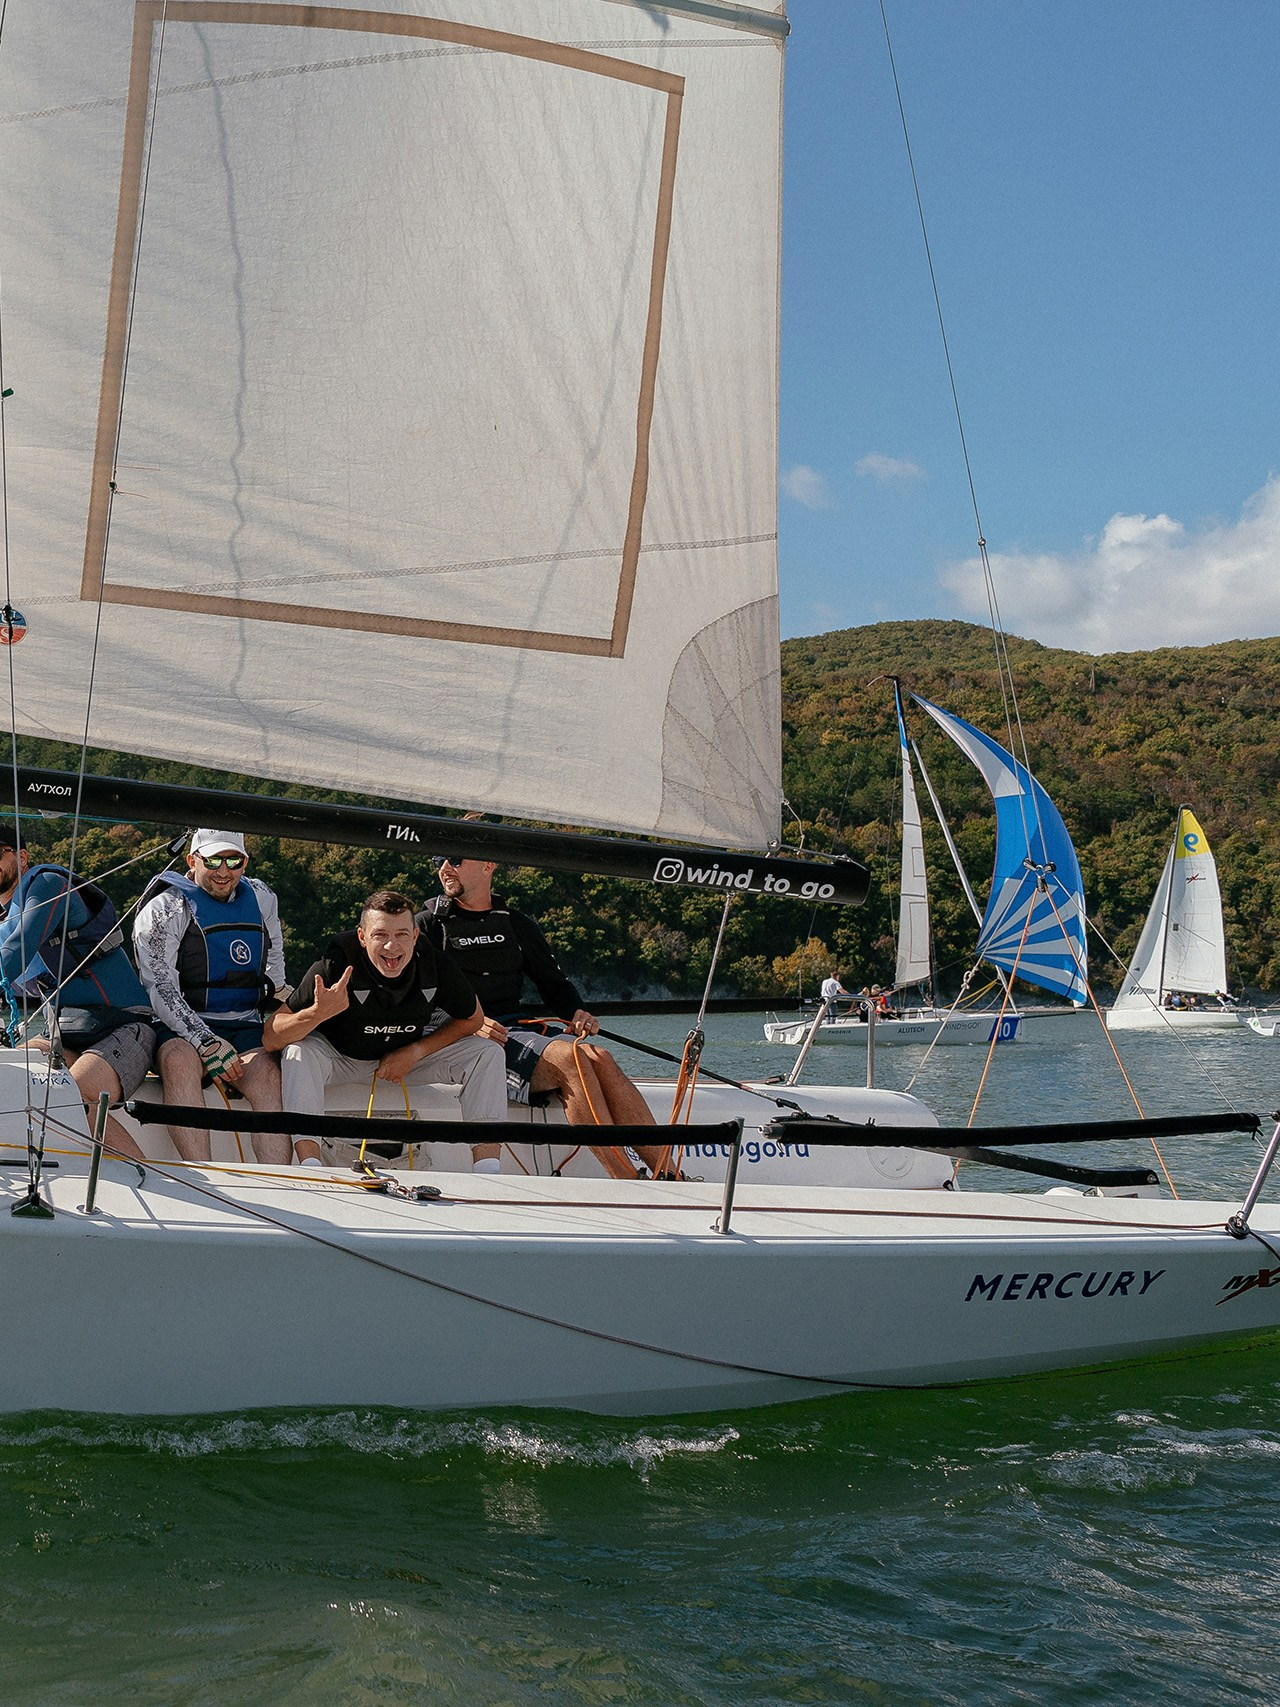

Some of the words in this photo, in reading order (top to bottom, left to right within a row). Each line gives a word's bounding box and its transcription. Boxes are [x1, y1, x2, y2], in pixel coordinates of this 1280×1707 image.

[27, 782, 72, 796] АУТХОЛ
[687, 863, 835, 899] wind_to_go
[458, 934, 505, 946] SMELO
[363, 1024, 417, 1035] SMELO
[897, 1026, 926, 1035] ALUTECH
[998, 1021, 1012, 1038] 10
[31, 1077, 71, 1086] ГИКА
[964, 1269, 1167, 1302] MERCURY
